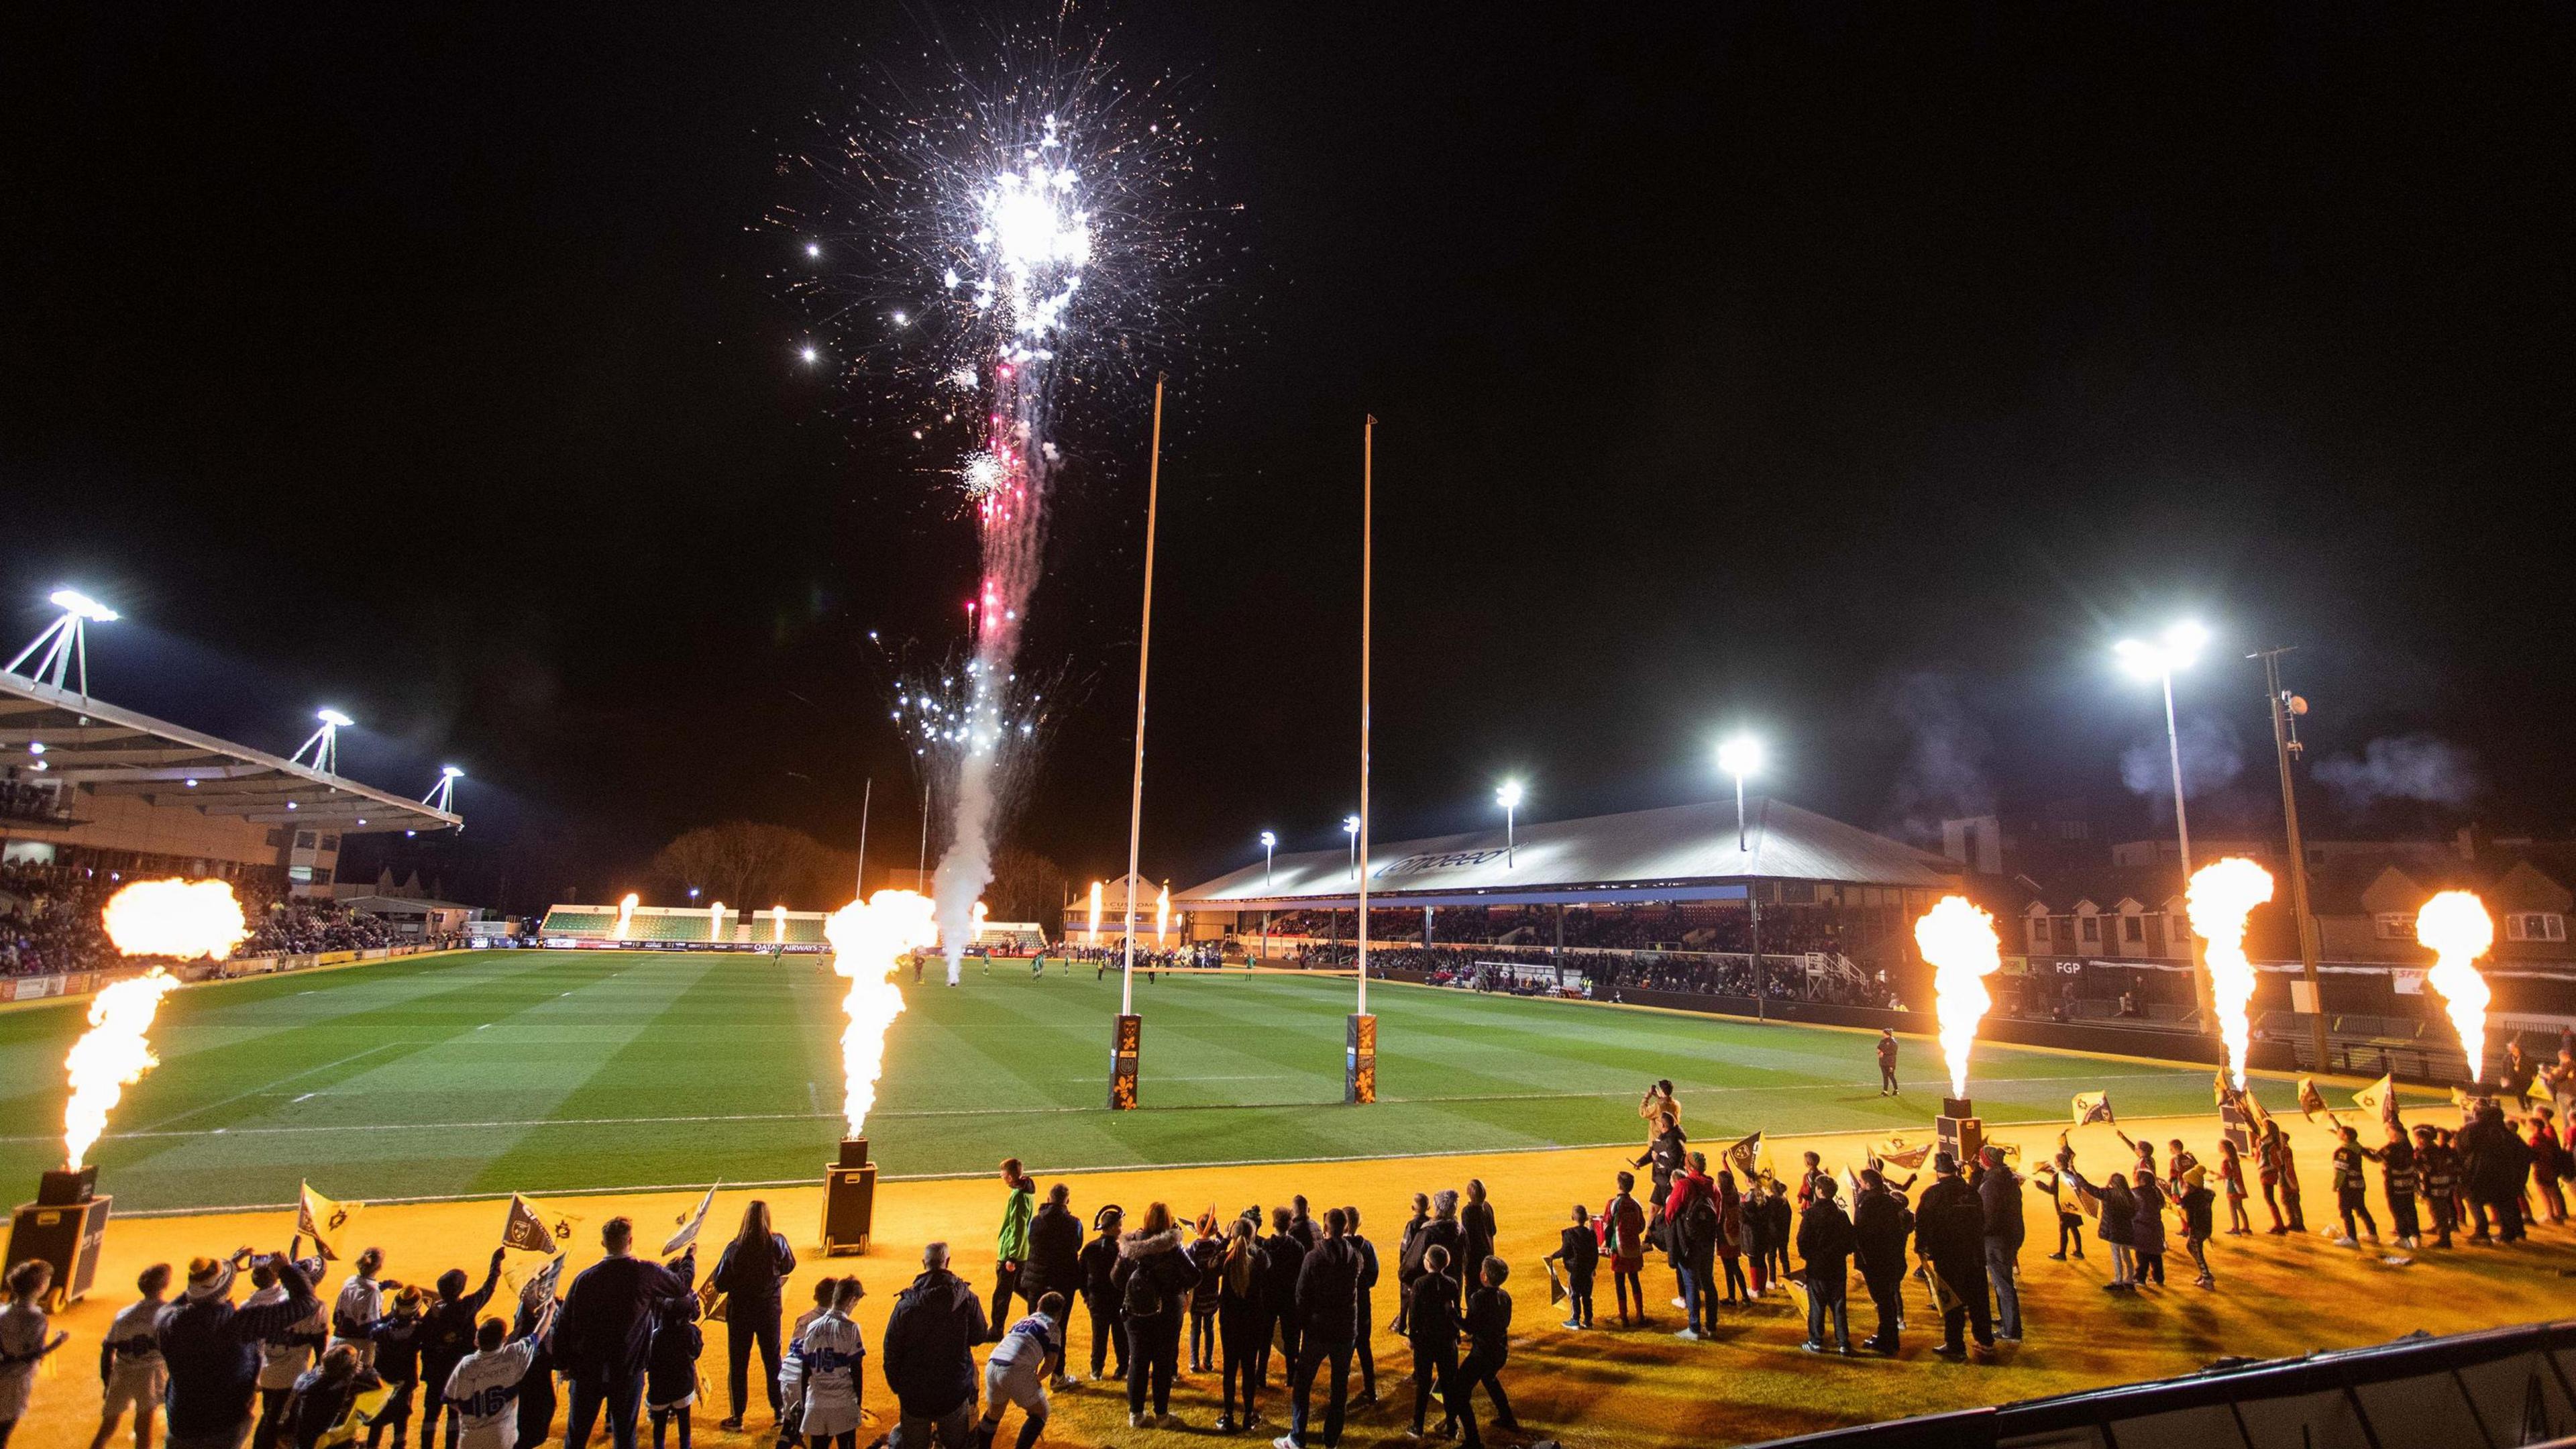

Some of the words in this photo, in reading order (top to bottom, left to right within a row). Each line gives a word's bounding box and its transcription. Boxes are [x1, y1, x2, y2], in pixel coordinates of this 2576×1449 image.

[2056, 962, 2080, 974] FGP
[815, 1346, 835, 1373] 15
[472, 1385, 506, 1418] 16
